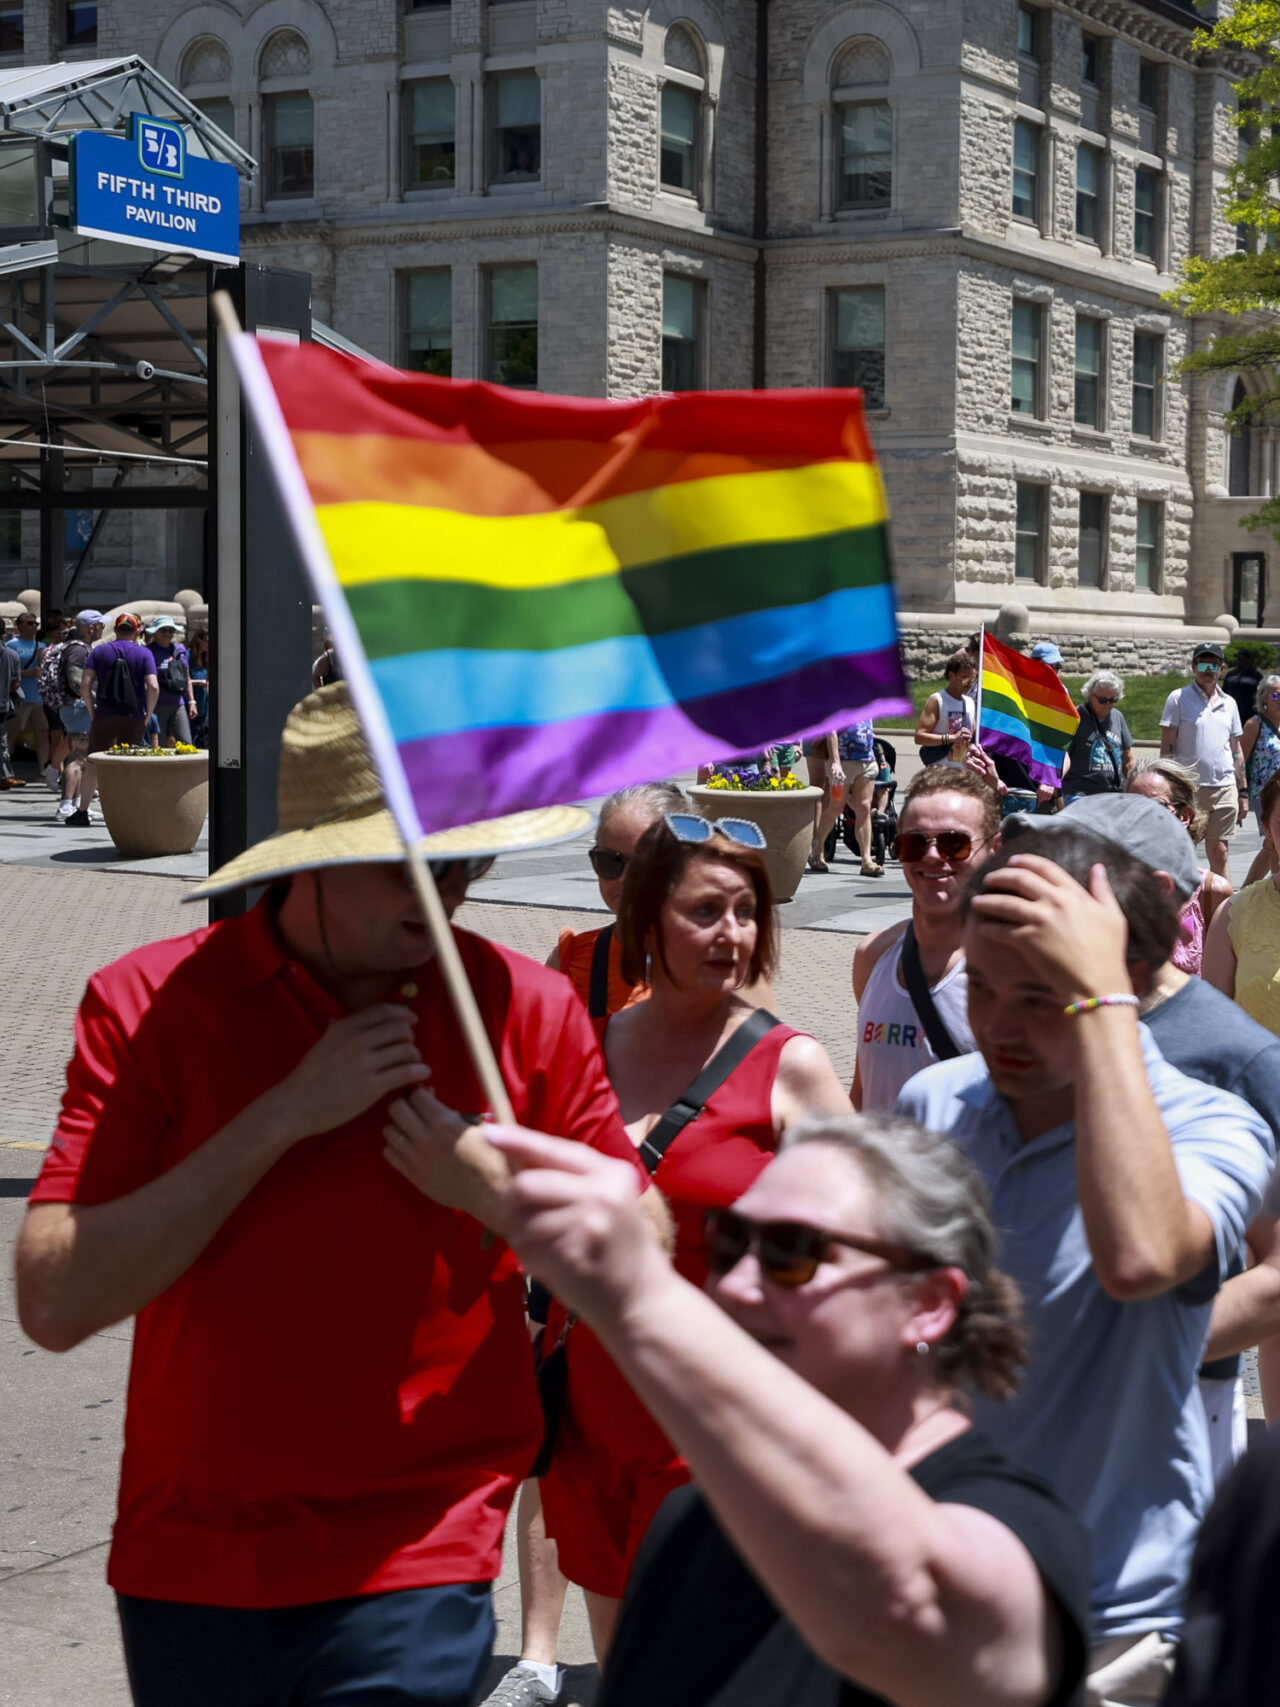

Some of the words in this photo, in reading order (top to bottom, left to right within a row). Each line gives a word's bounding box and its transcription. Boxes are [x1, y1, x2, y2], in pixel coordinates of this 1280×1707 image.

[97, 171, 155, 201] FIFTH
[162, 186, 222, 214] THIRD
[125, 204, 197, 233] PAVILION
